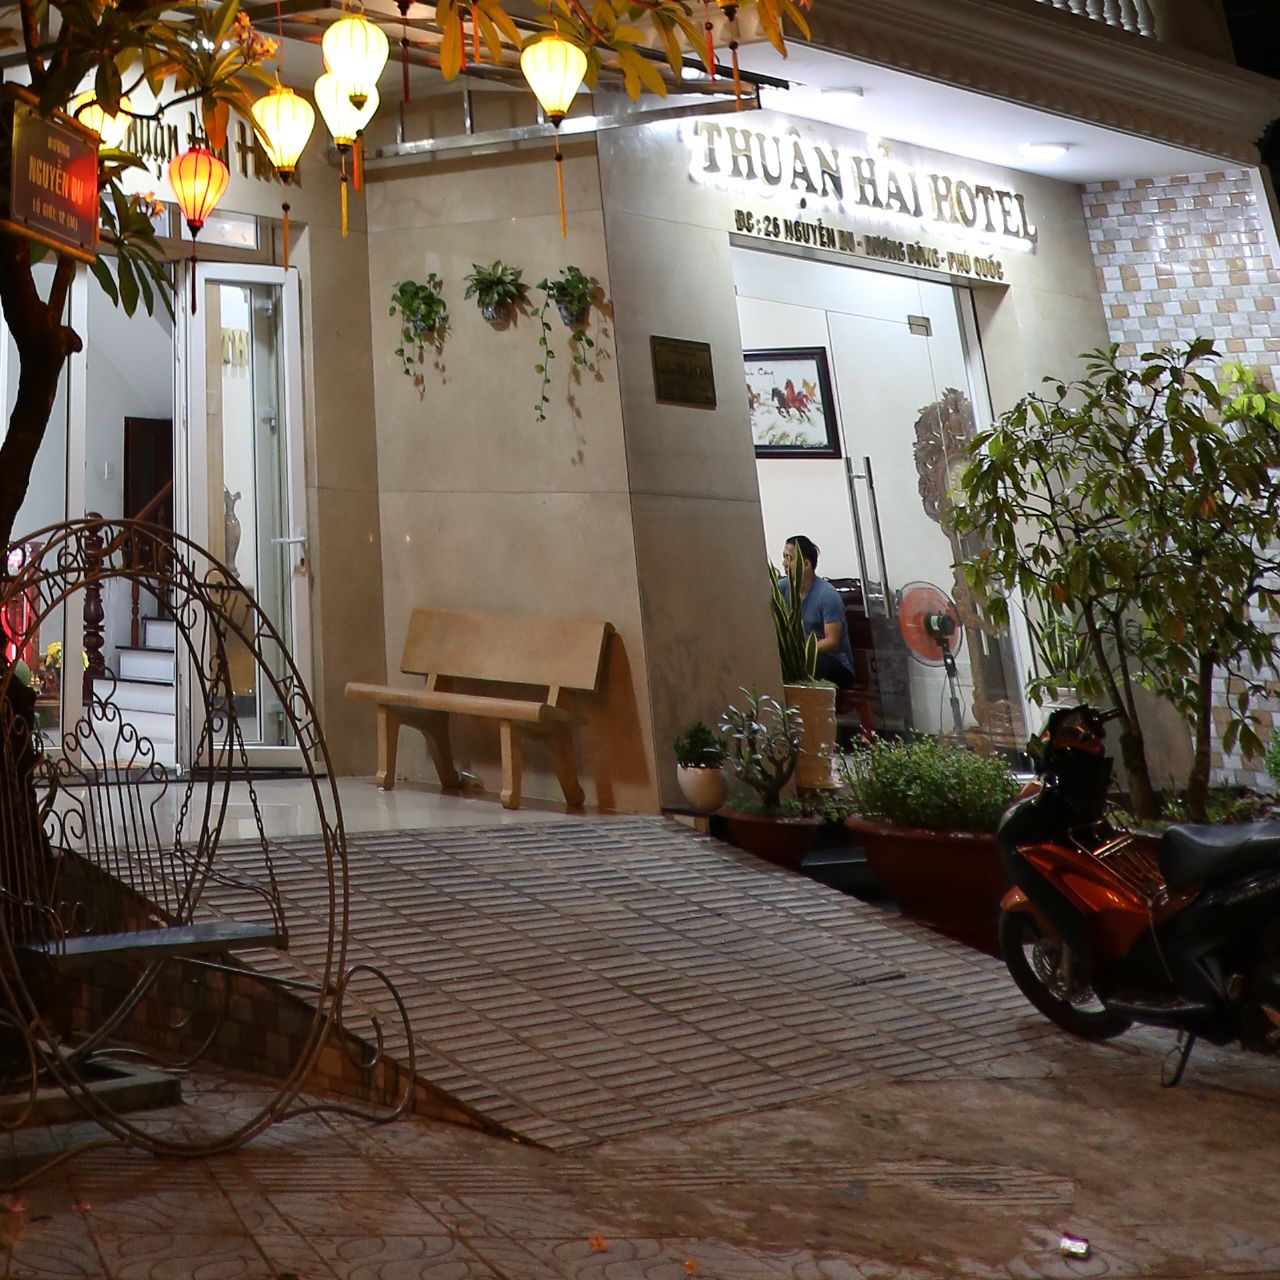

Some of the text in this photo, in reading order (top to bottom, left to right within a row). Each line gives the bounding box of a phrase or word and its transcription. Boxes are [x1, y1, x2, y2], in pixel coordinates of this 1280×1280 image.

[28, 153, 70, 200] NGUYỄN
[693, 119, 844, 209] THUẬN
[927, 173, 1038, 245] HOTEL
